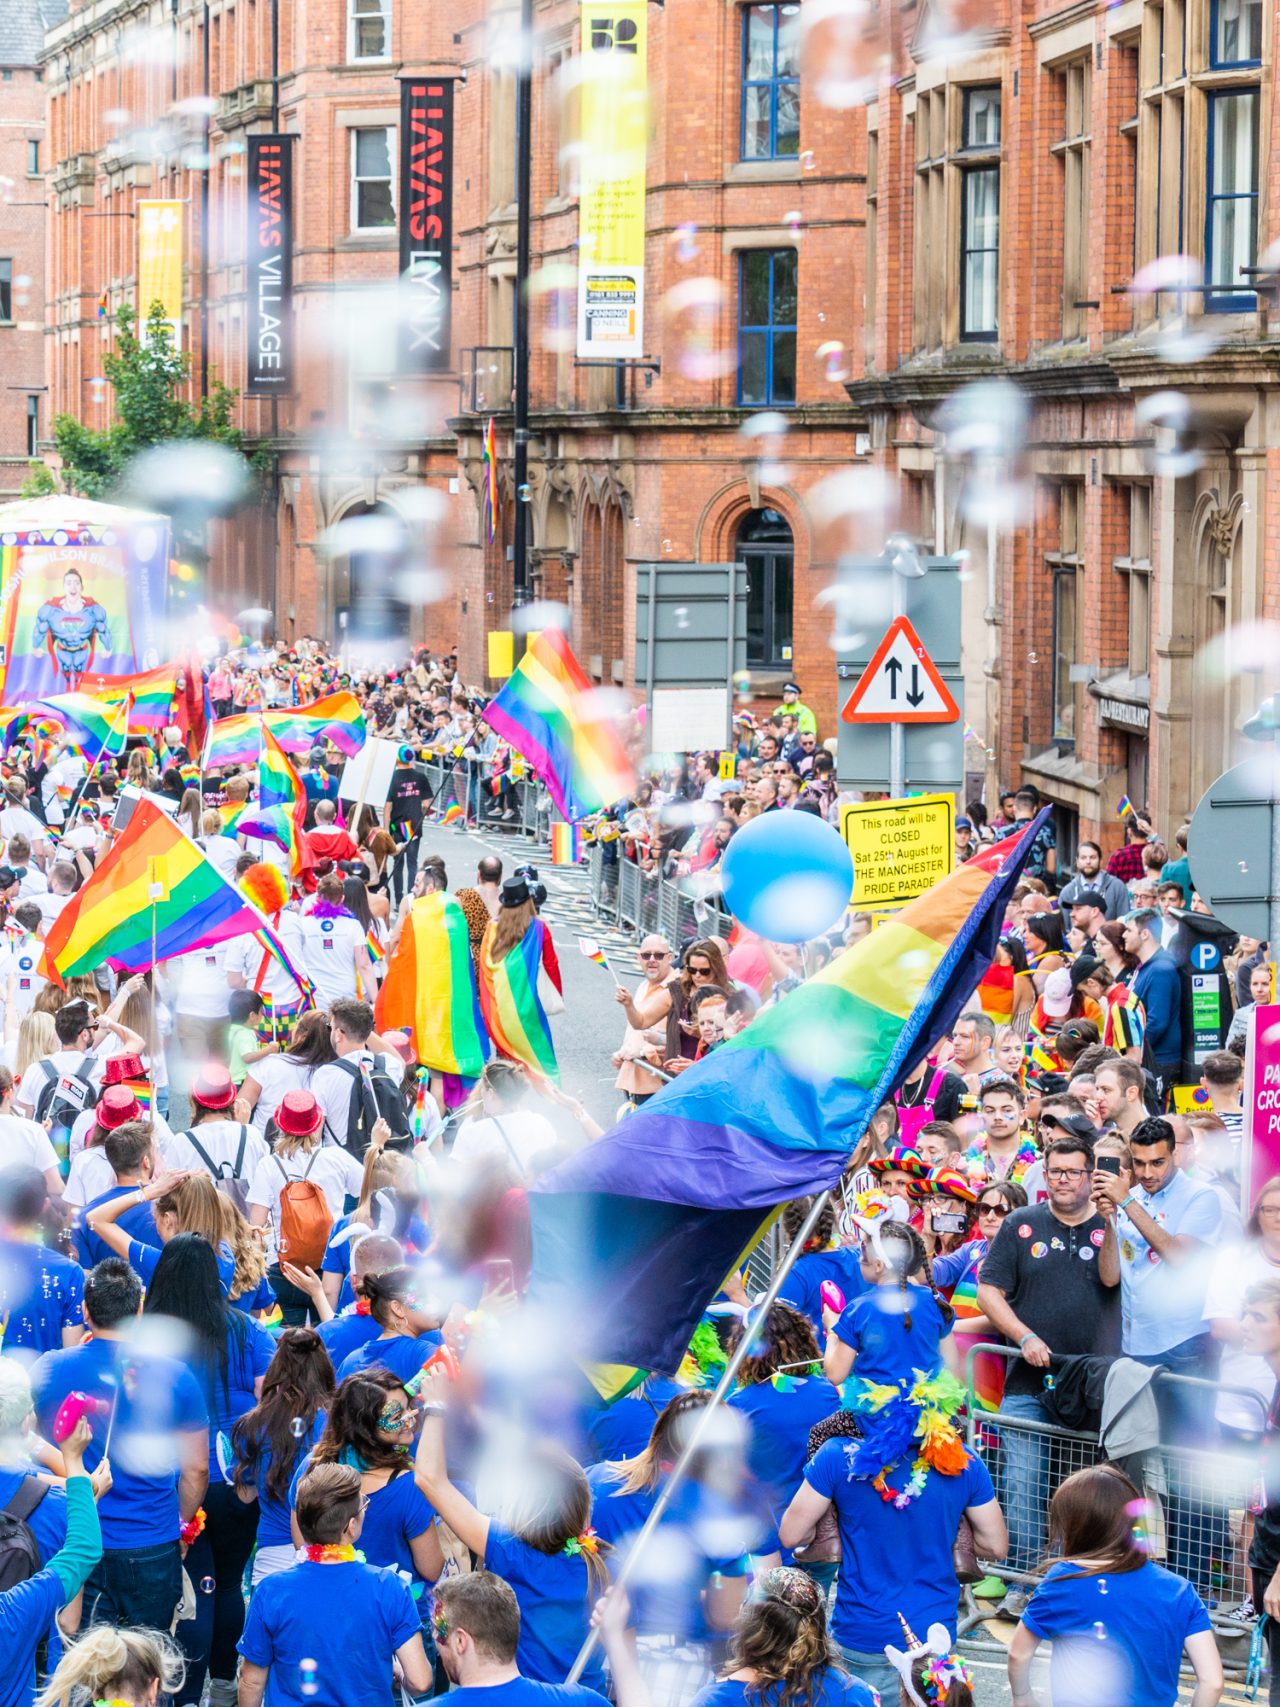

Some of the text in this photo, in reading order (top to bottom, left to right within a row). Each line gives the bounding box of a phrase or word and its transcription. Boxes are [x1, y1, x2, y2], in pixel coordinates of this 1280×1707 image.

[410, 86, 443, 240] HAVAS
[259, 146, 281, 247] HAVAS
[259, 254, 281, 369] VILLAGE
[861, 813, 937, 830] This road will be
[880, 830, 920, 844] CLOSED
[855, 852, 871, 864] Sat
[897, 846, 929, 861] August
[931, 845, 943, 855] for
[855, 860, 944, 879] THE MANCHESTER
[864, 877, 935, 895] PRIDE PARADE
[1200, 943, 1217, 969] P
